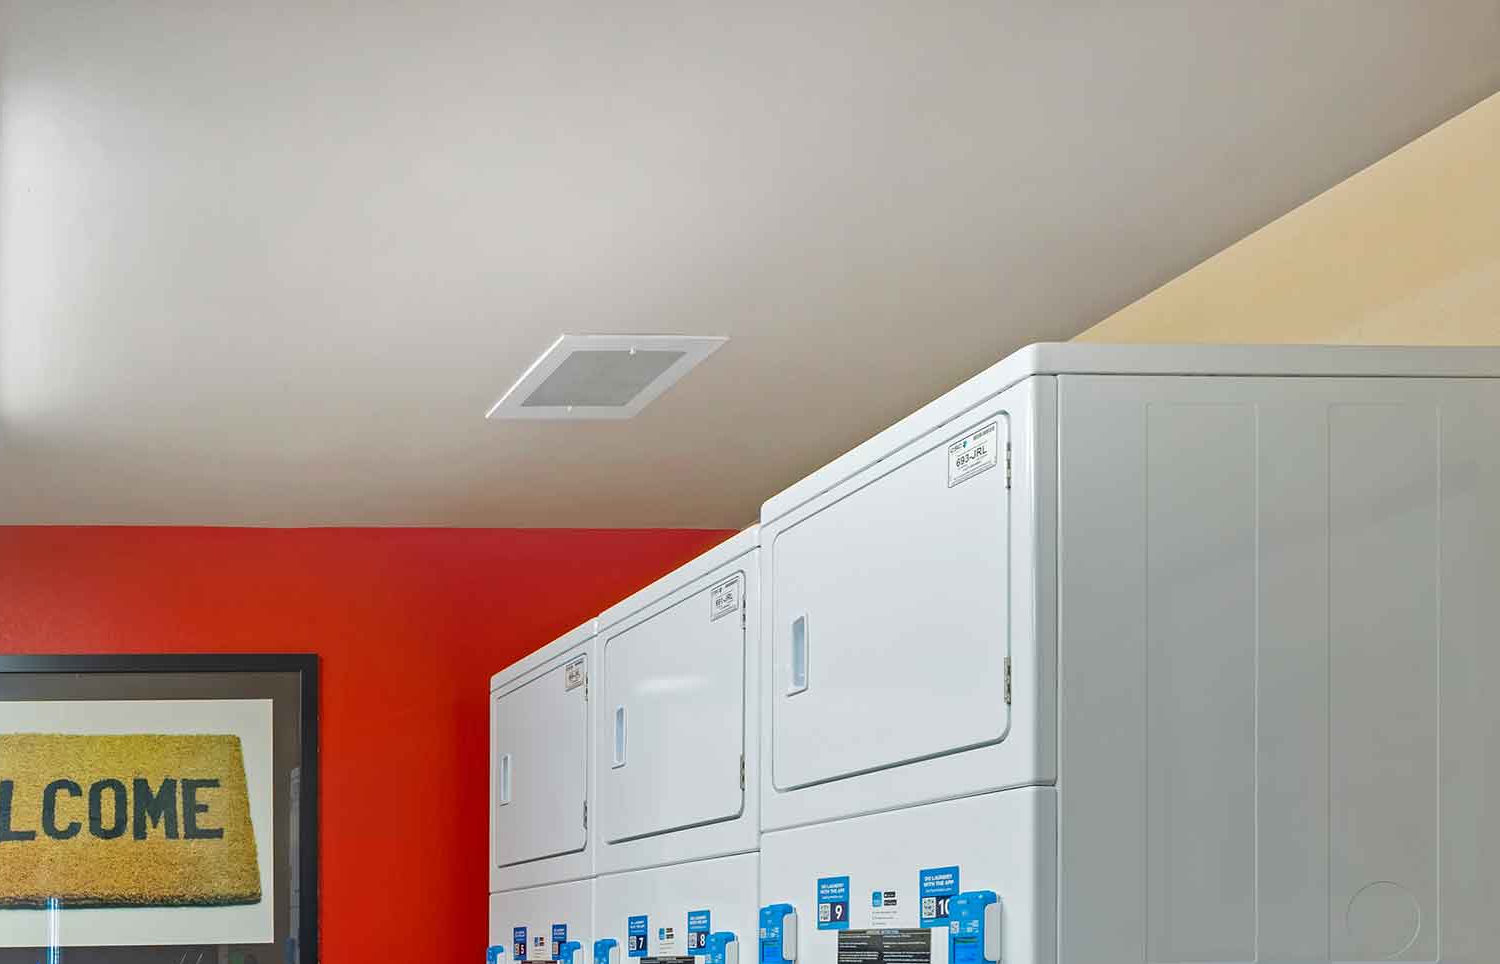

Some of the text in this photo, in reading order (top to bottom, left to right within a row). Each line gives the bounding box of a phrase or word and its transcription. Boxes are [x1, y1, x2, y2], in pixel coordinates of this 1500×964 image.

[835, 904, 843, 920] 9
[638, 937, 645, 949] 7
[699, 933, 706, 947] 8
